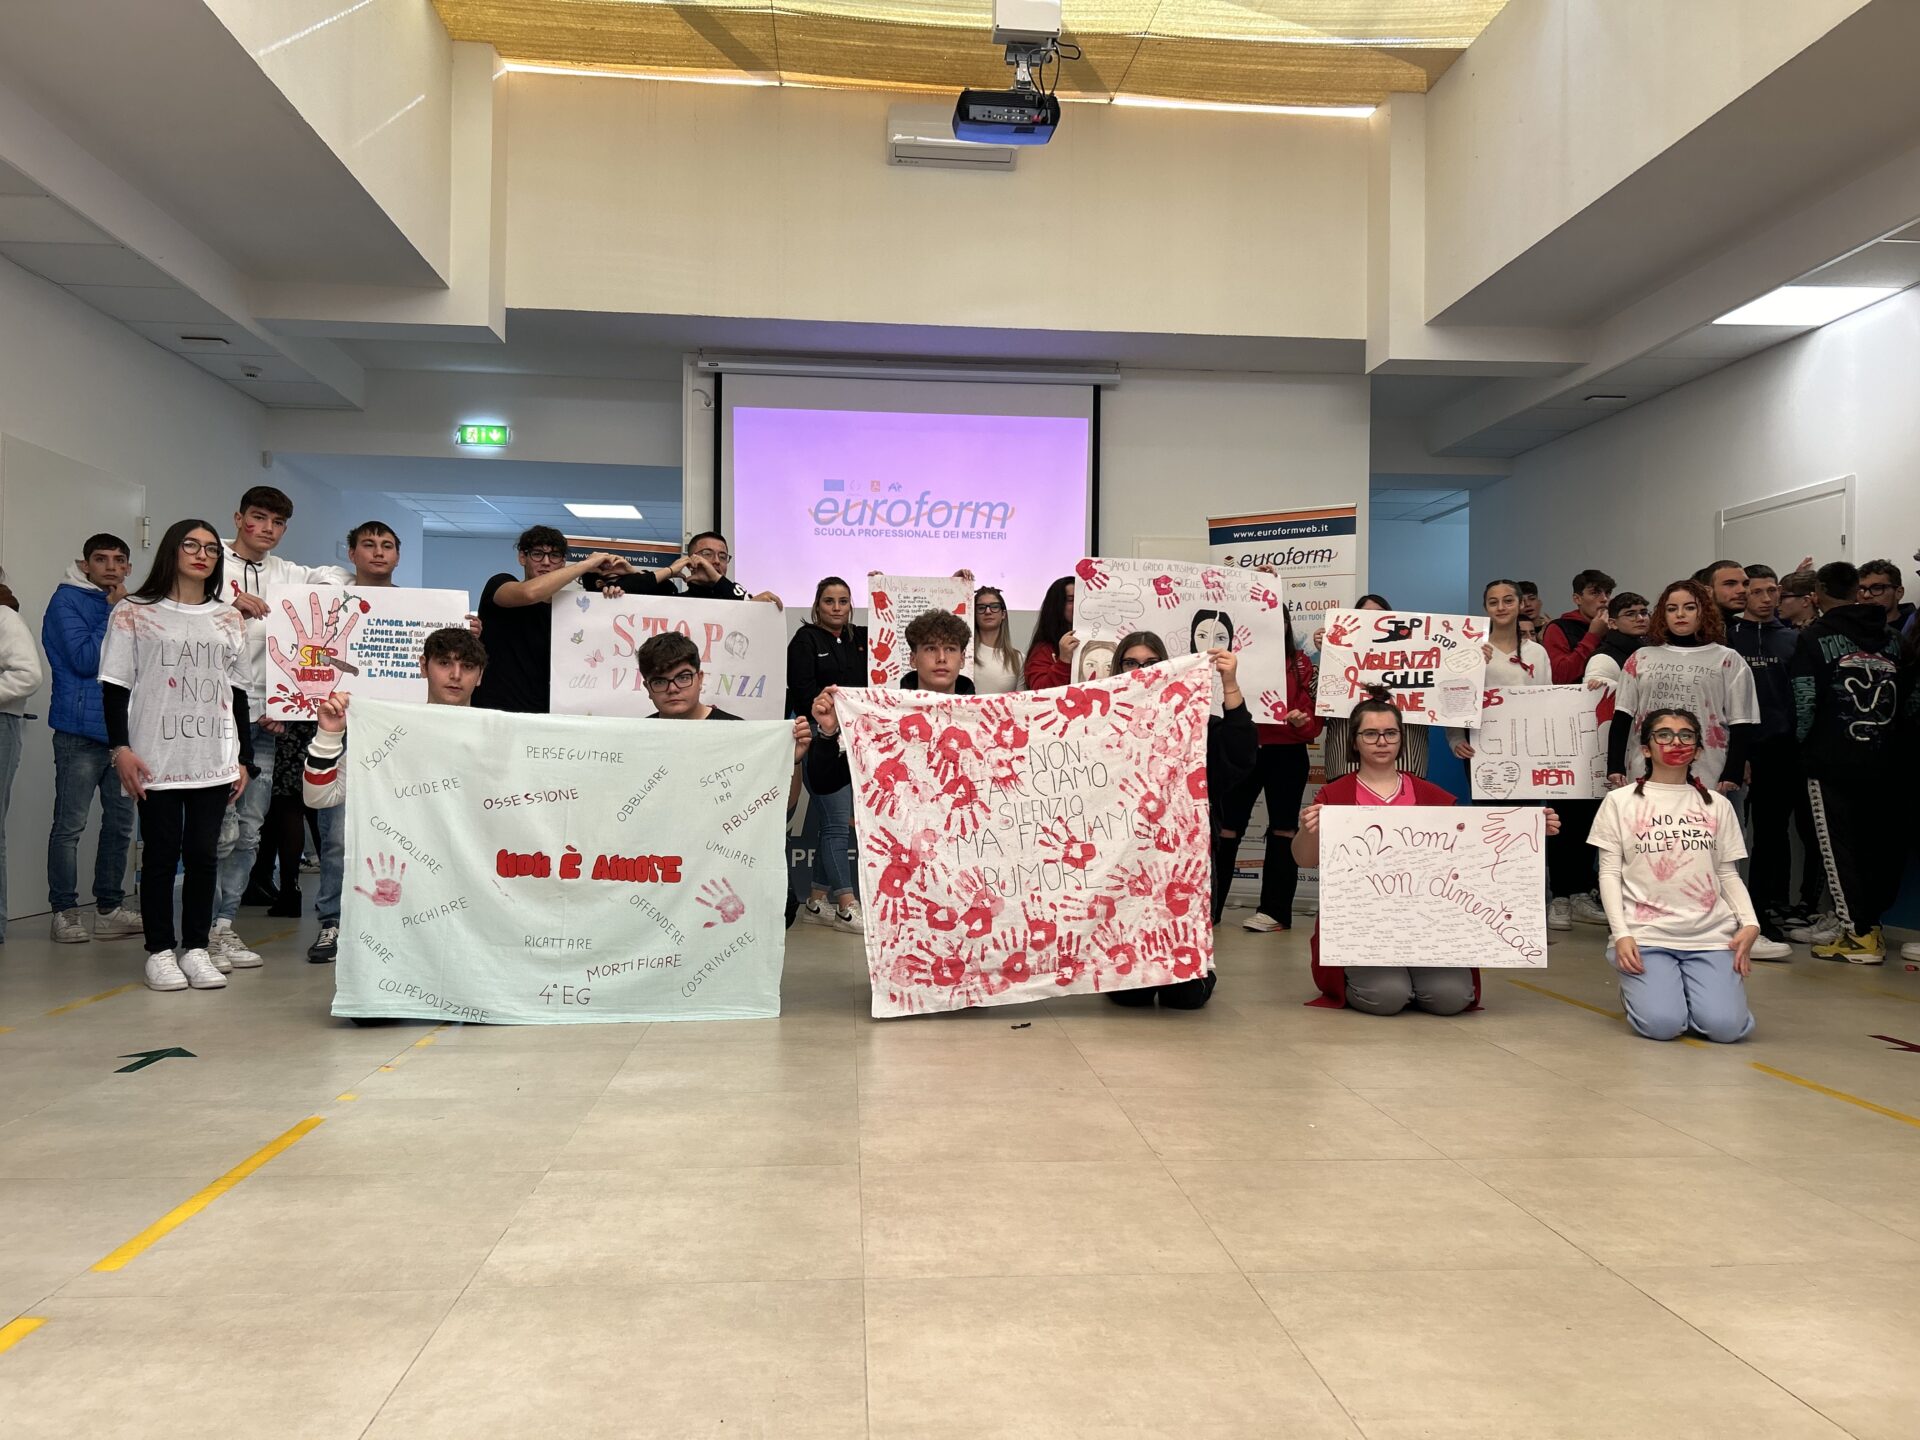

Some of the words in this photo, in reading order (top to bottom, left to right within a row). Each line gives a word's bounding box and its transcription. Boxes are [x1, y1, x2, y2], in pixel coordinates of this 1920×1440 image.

[814, 490, 1010, 530] euroform
[814, 527, 855, 538] SCUOLA
[857, 528, 940, 539] PROFESSIONALE
[943, 530, 959, 540] DEI
[961, 531, 1007, 541] MESTIERI
[1233, 524, 1329, 539] www.euroformweb.it
[1102, 560, 1131, 573] SIAMO
[1142, 561, 1164, 572] GRIDO
[1240, 547, 1333, 568] euroform
[1296, 602, 1303, 611] A
[1304, 600, 1340, 611] COLORI
[363, 628, 394, 636] L'AMORE
[367, 618, 404, 627] L'AMORE
[362, 636, 395, 644] L'AMORE
[1431, 633, 1458, 651] STOP
[358, 651, 390, 659] L'AMORE
[1353, 647, 1442, 671] VIOLENZA
[368, 668, 407, 678] L'AMORE
[1381, 671, 1435, 689] SULLE
[1647, 663, 1684, 673] SIAMO
[1687, 664, 1717, 679] STATE
[1648, 672, 1685, 683] AMATE
[1693, 675, 1702, 685] E
[612, 667, 767, 699] VIENZA
[1657, 681, 1692, 694] ODIATE
[1690, 694, 1697, 703] E
[359, 725, 408, 772] ISOLARE
[526, 745, 625, 764] PERSEGUITARE
[1029, 740, 1081, 775] NON
[700, 762, 745, 788] SCATTO
[721, 780, 732, 790] DI
[1532, 769, 1575, 786] BASTA
[394, 777, 461, 800] UCCIDERE
[483, 788, 579, 810] OSSESSIONE
[616, 765, 669, 823] OBBLIGARE
[714, 791, 733, 805] IRA
[722, 785, 781, 835] ABUSARE
[999, 794, 1084, 831] SILENZIO
[1652, 814, 1674, 827] NO
[1678, 816, 1708, 826] ALLA
[370, 815, 444, 876] CONTROLLARE
[956, 828, 1004, 865] MA
[1018, 807, 1153, 850] FACCIAMO
[1393, 822, 1466, 853] nomi
[1635, 829, 1713, 841] VIOLENZA
[705, 839, 757, 869] UMILIARE
[1635, 841, 1674, 854] SULLE
[1681, 839, 1719, 851] DONNE
[559, 845, 583, 880] È
[983, 855, 1102, 898] RUMORE
[1365, 871, 1413, 896] non
[402, 896, 470, 929] PICCHIARE
[629, 894, 687, 947] OFFENDERE
[359, 930, 395, 964] URLARE
[524, 935, 593, 950] RICATTARE
[586, 953, 683, 983] MORTIFICARE
[681, 931, 757, 1000] COSTRINGERE
[378, 978, 492, 1024] COLPEVOLIZZARE
[563, 985, 592, 1006] EG
